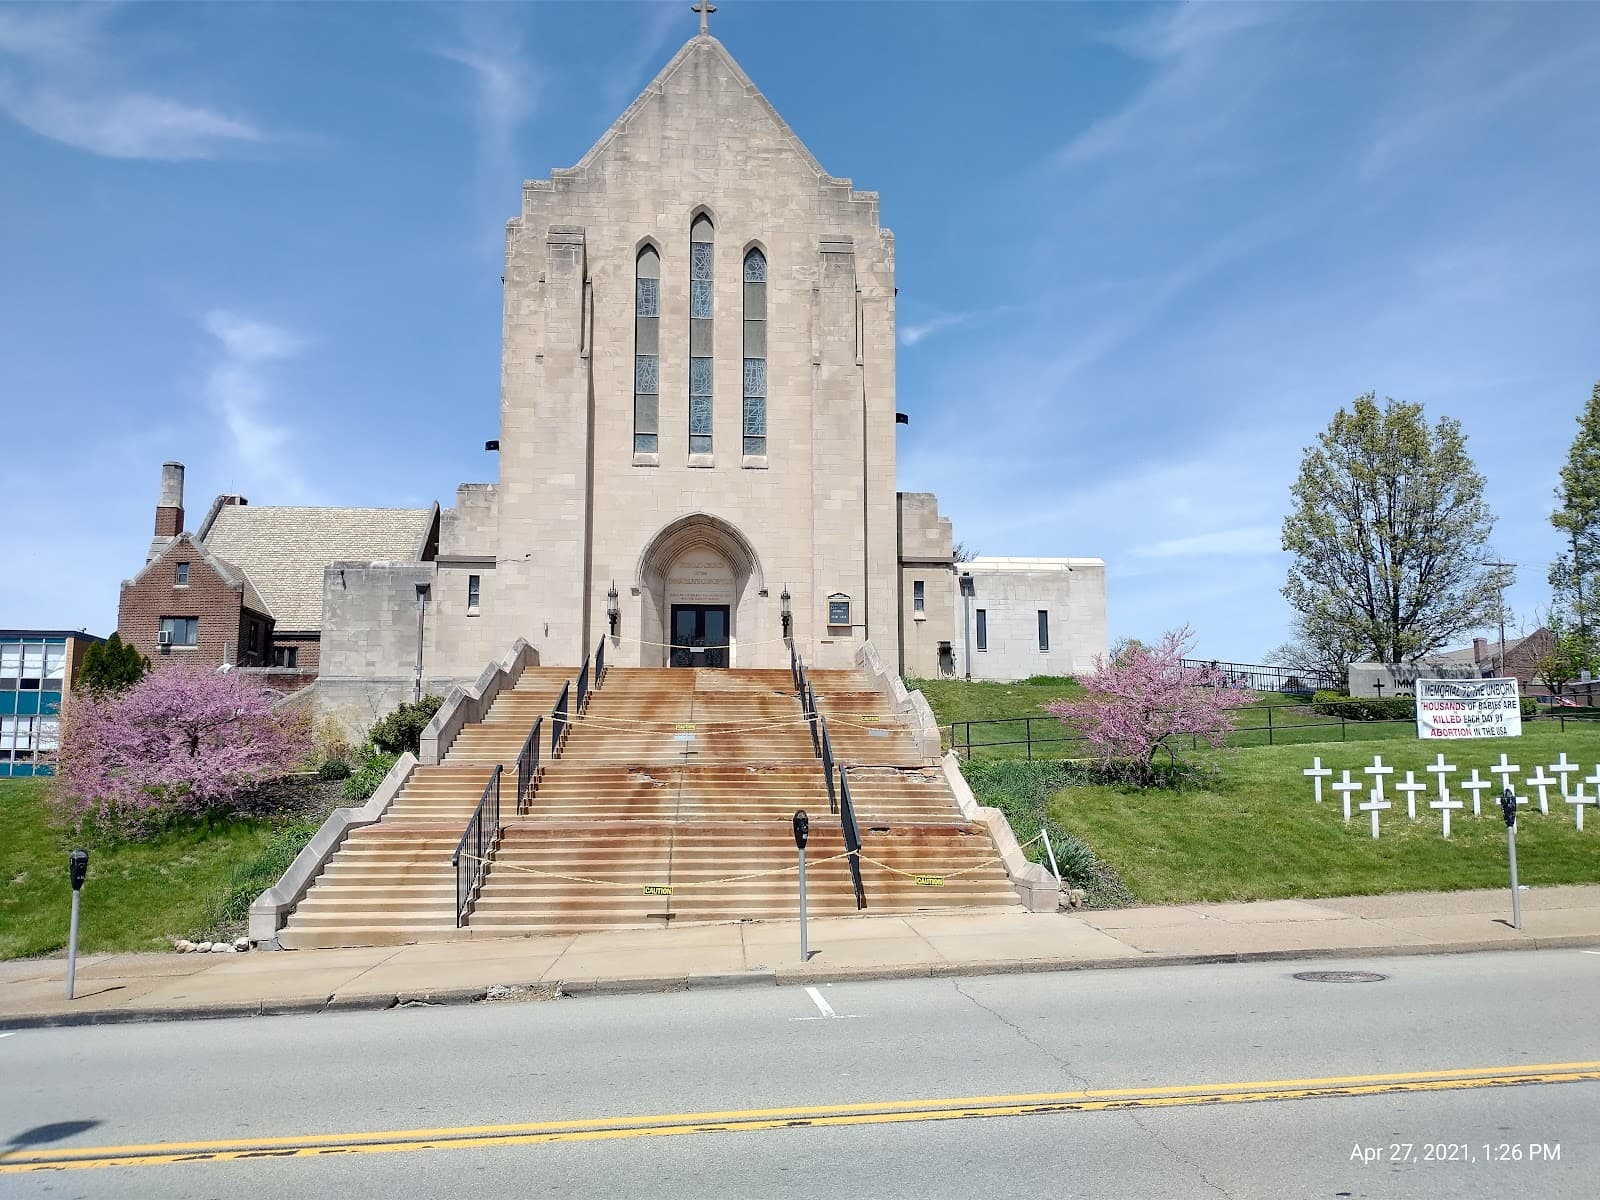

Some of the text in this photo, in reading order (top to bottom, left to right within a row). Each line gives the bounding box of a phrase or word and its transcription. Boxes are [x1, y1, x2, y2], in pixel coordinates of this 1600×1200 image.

[1486, 683, 1516, 696] UNBORN
[1421, 699, 1518, 711] HOUSANDS OF BABIES ARE
[1432, 713, 1504, 724] KILLED EACH DAY BY
[1430, 726, 1508, 737] ABORTION IN THE USA
[916, 877, 943, 886] CAUTION
[644, 886, 672, 896] CAUTION
